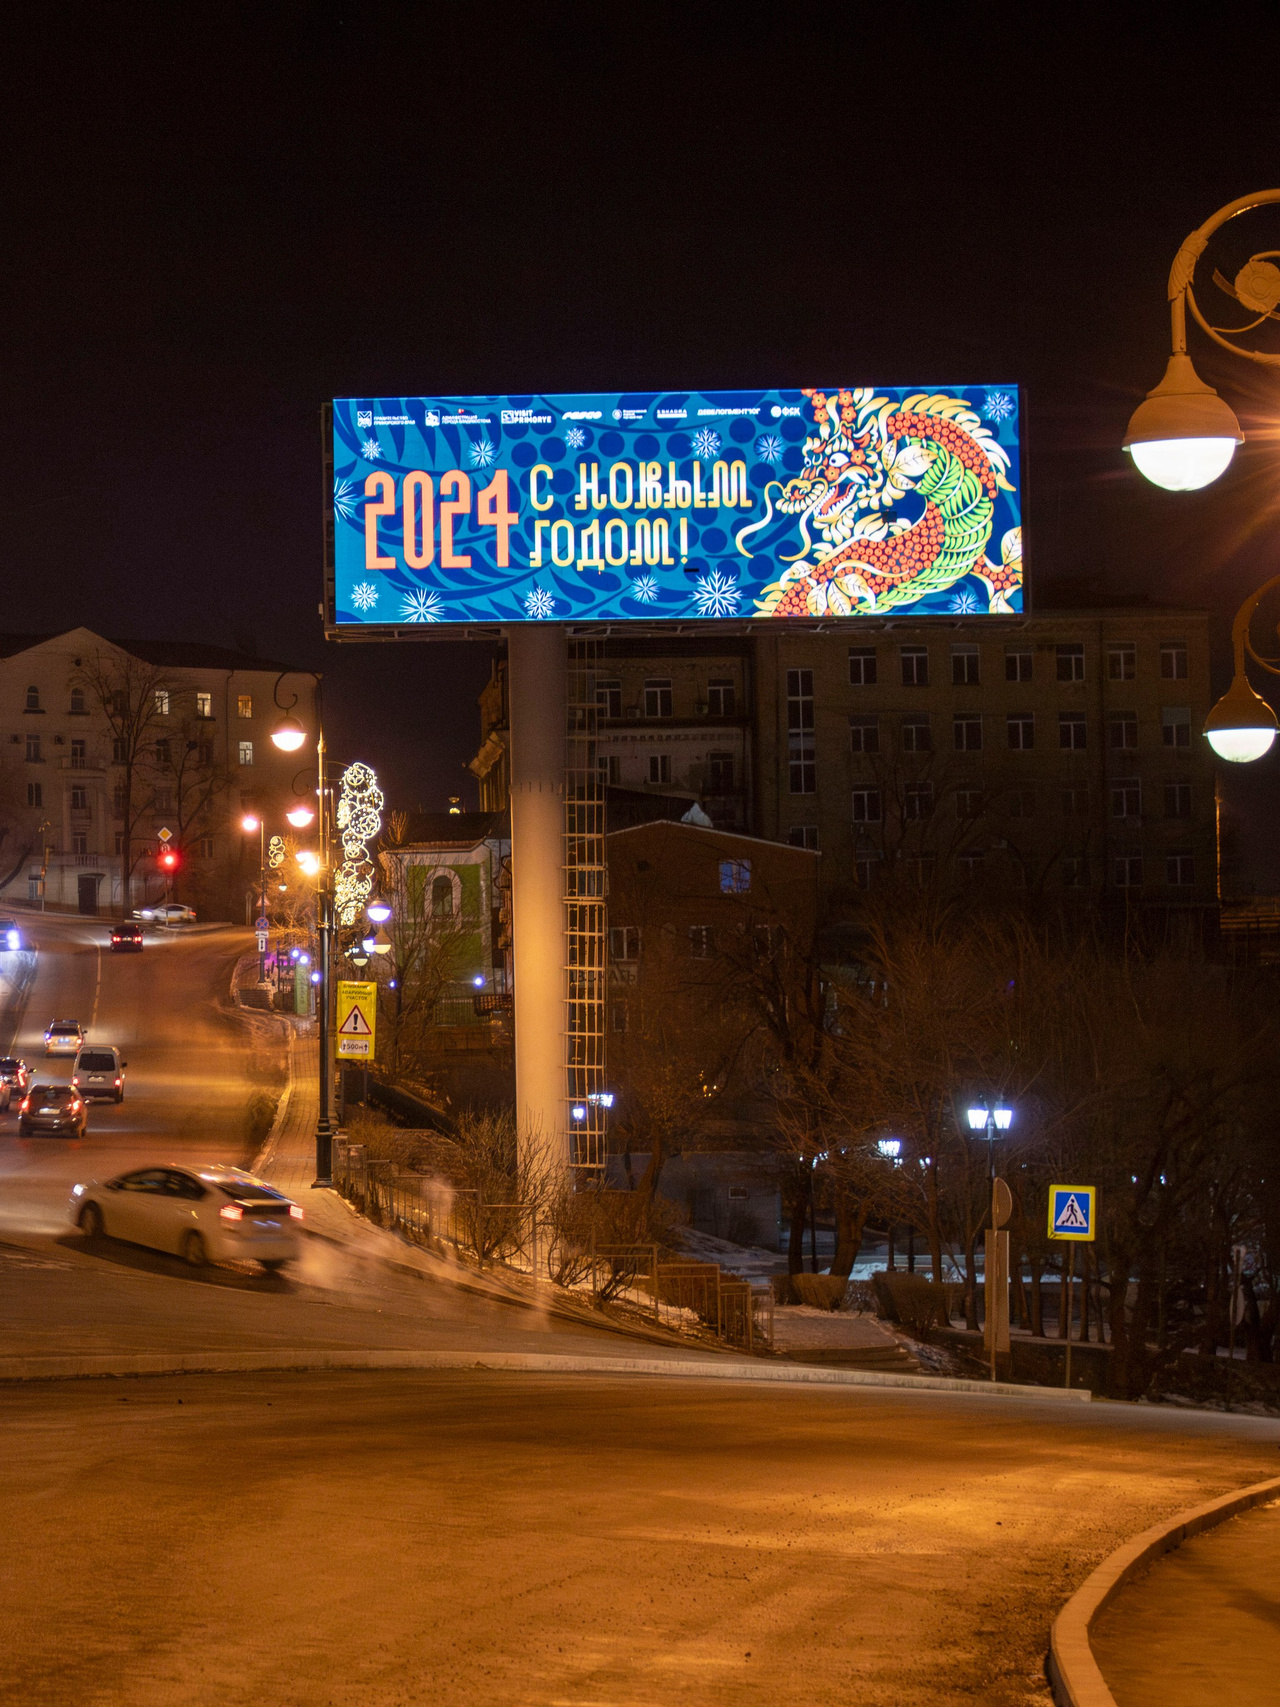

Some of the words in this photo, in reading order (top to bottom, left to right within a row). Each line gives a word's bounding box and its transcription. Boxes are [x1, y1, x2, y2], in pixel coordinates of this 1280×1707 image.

[514, 416, 552, 424] PRIMORYE
[782, 406, 801, 416] ФСК
[530, 464, 553, 511] С
[575, 460, 753, 511] НОВЫМ
[364, 469, 519, 570] 2024
[530, 517, 688, 571] ГОДОМ!
